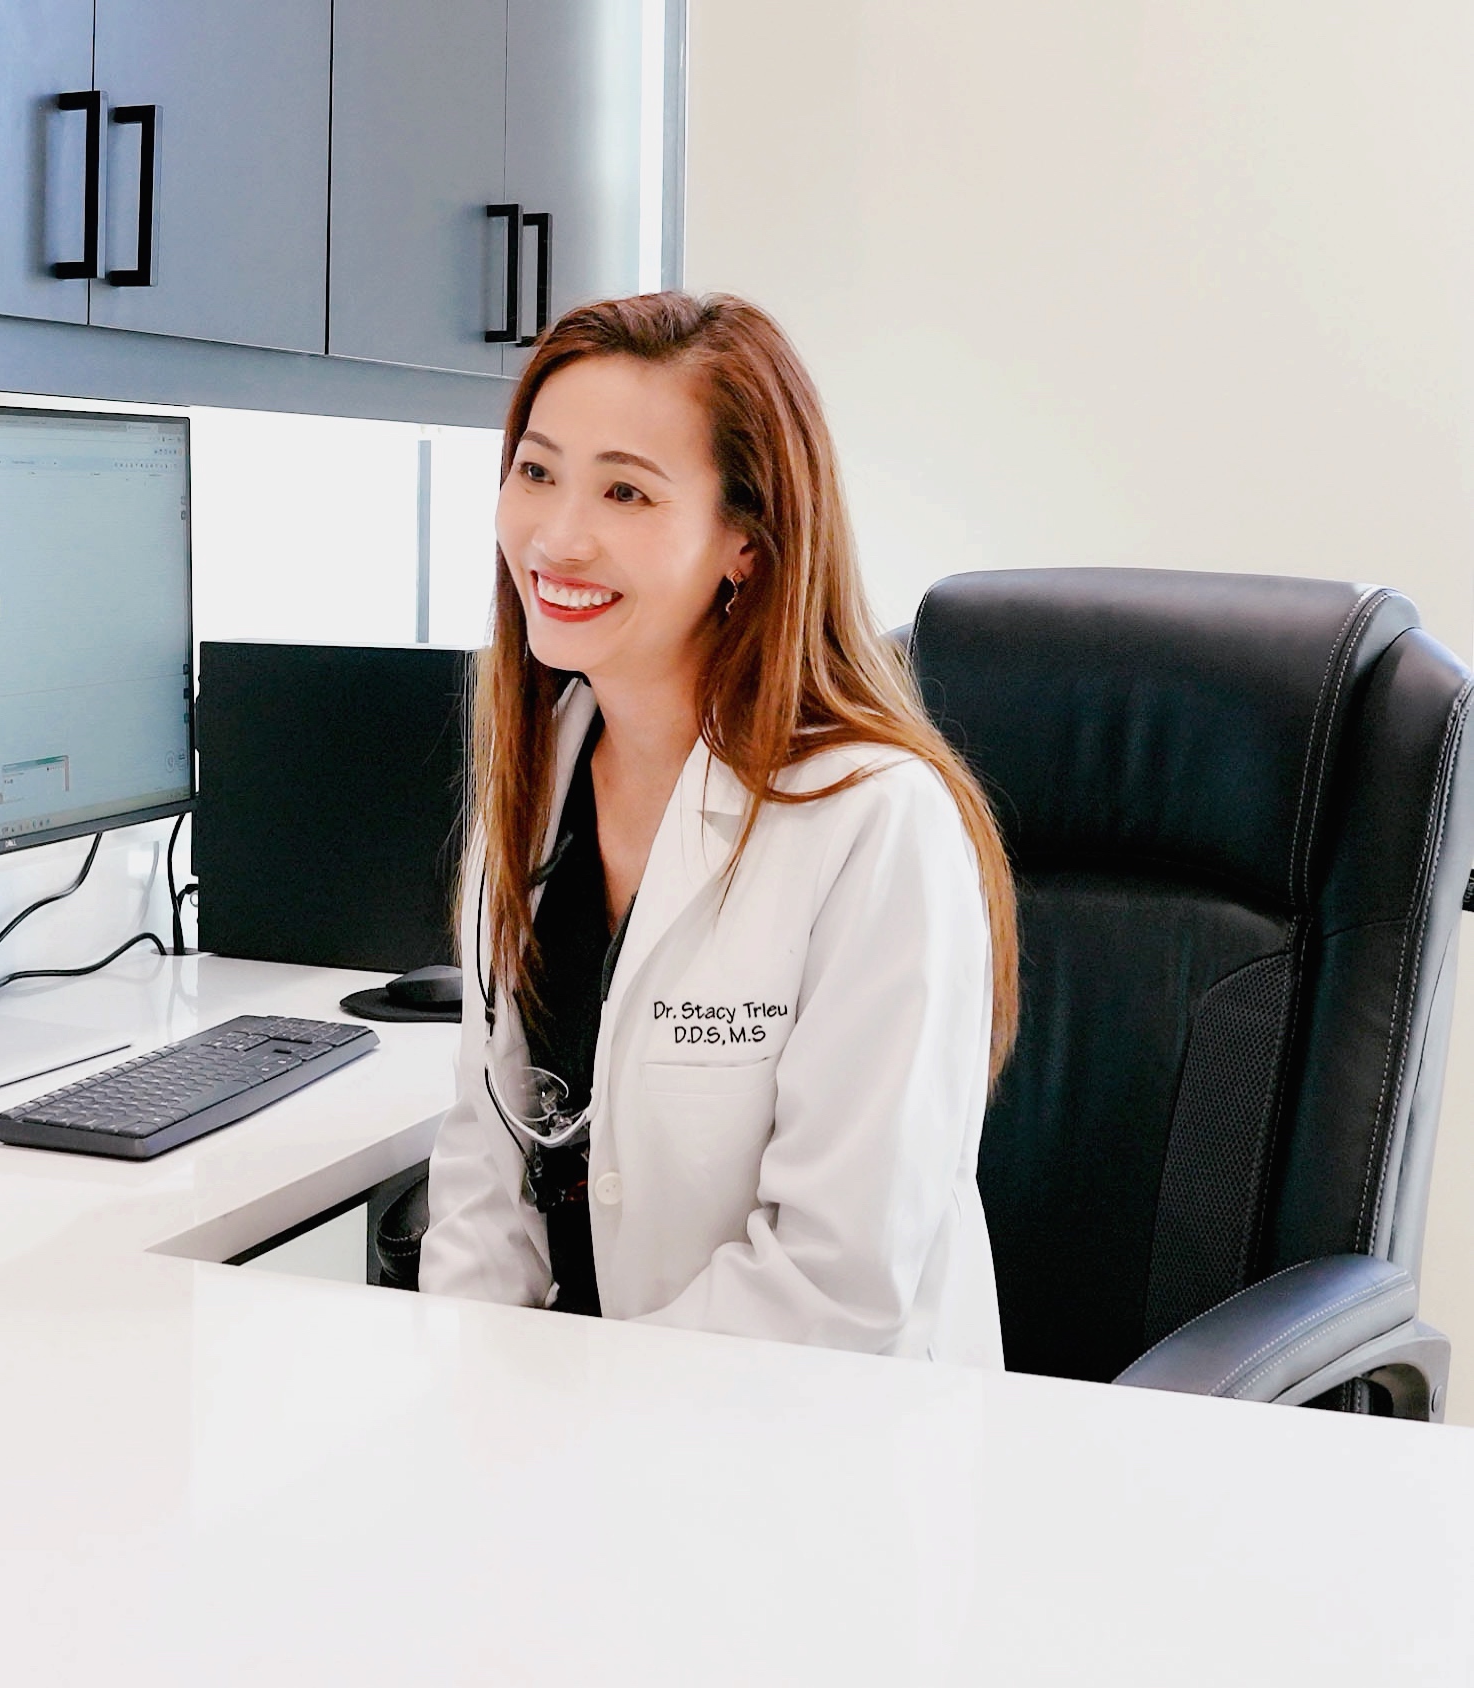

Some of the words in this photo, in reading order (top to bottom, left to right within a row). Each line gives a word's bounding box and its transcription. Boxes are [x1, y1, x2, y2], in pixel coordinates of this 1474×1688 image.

[654, 1000, 676, 1020] Dr.
[682, 1002, 736, 1024] Stacy
[730, 1025, 766, 1042] M.S
